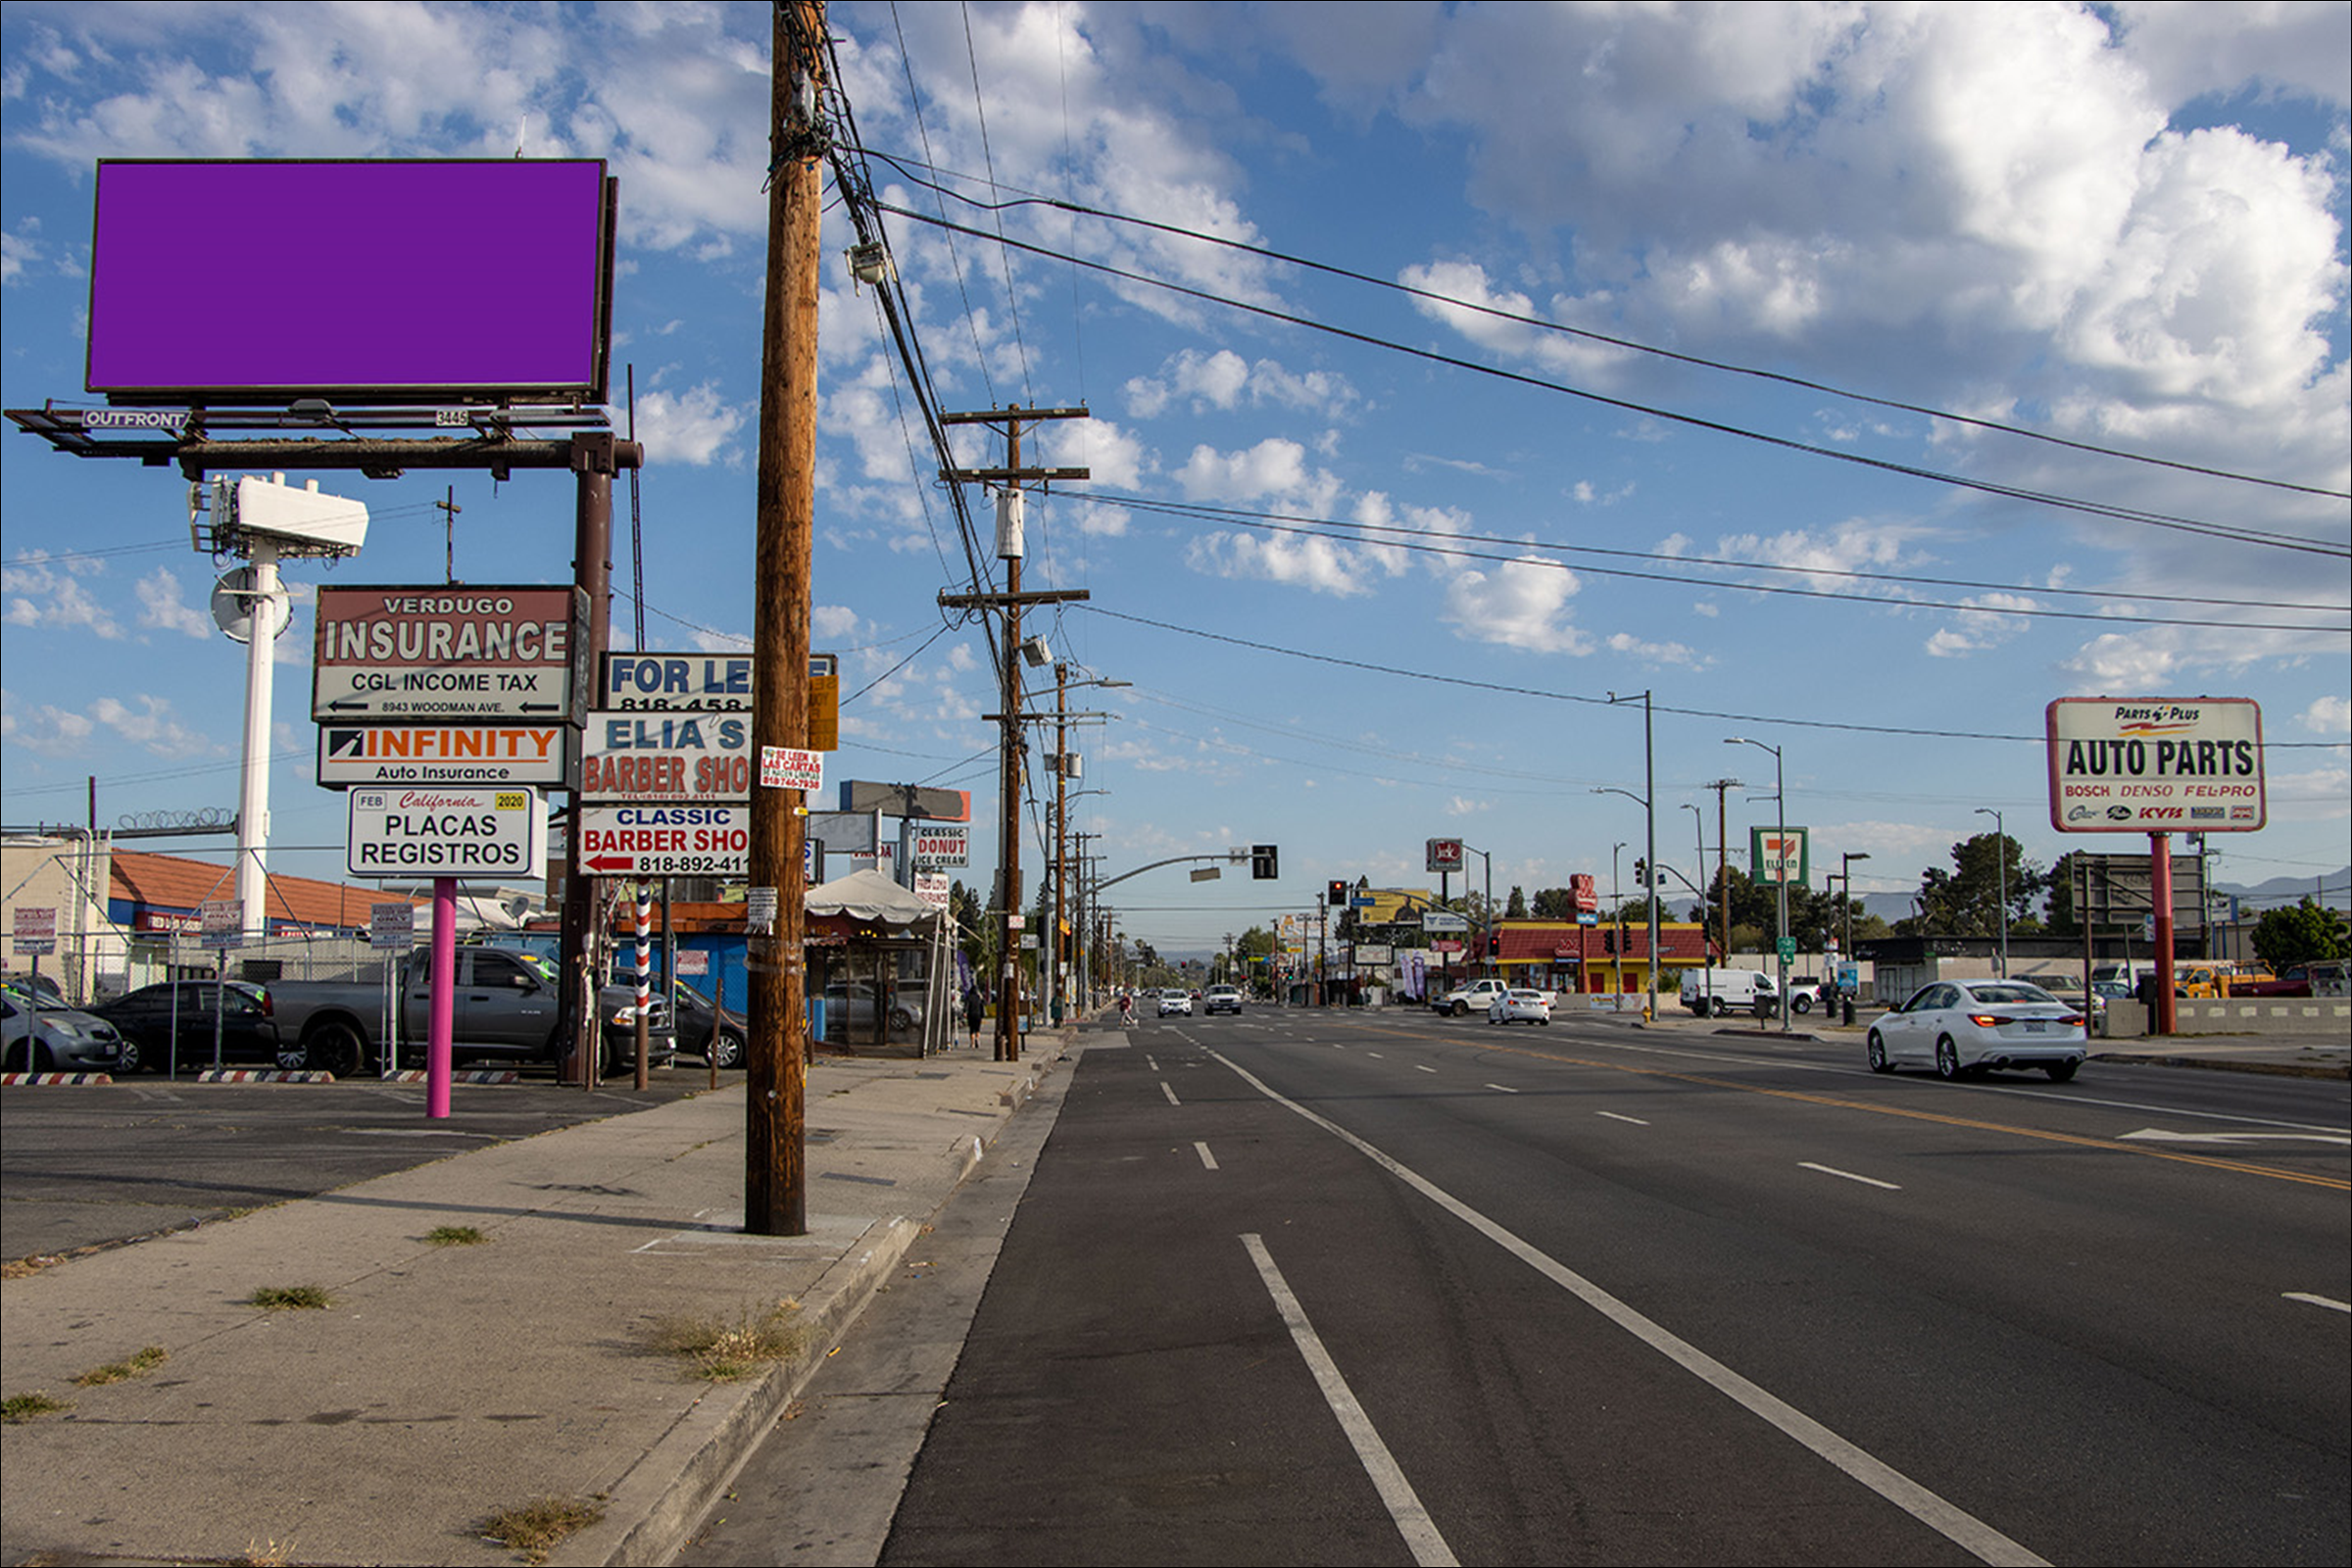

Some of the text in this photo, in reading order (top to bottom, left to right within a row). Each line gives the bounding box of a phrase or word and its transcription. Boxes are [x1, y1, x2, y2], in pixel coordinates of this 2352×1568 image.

[86, 411, 185, 425] OUTFRONT
[383, 598, 514, 614] VERDUGO
[323, 621, 567, 661] INSURANCE
[351, 673, 538, 691] CGL INCOME TAX
[612, 659, 690, 694] FOR
[382, 703, 505, 712] 8943 WOODMAN AVE.
[607, 713, 745, 750] ELIA'S
[367, 730, 558, 757] INFINITY
[762, 759, 820, 773] LAS CARTAS
[2066, 740, 2254, 775] AUTO PARTS
[375, 765, 510, 779] Auto Insurance
[583, 756, 749, 793] BARBER SHO
[2065, 785, 2256, 797] BOSCH DENSO FEL-PRO
[360, 790, 523, 811] FEB California 2020
[616, 809, 731, 825] CLASSIC
[2138, 807, 2183, 818] KYB
[385, 814, 497, 836] PLACAS
[921, 828, 963, 837] CLASSIC
[584, 829, 748, 852] BARBER SHO
[918, 839, 965, 854] DONUT
[361, 843, 520, 864] REGISTROS
